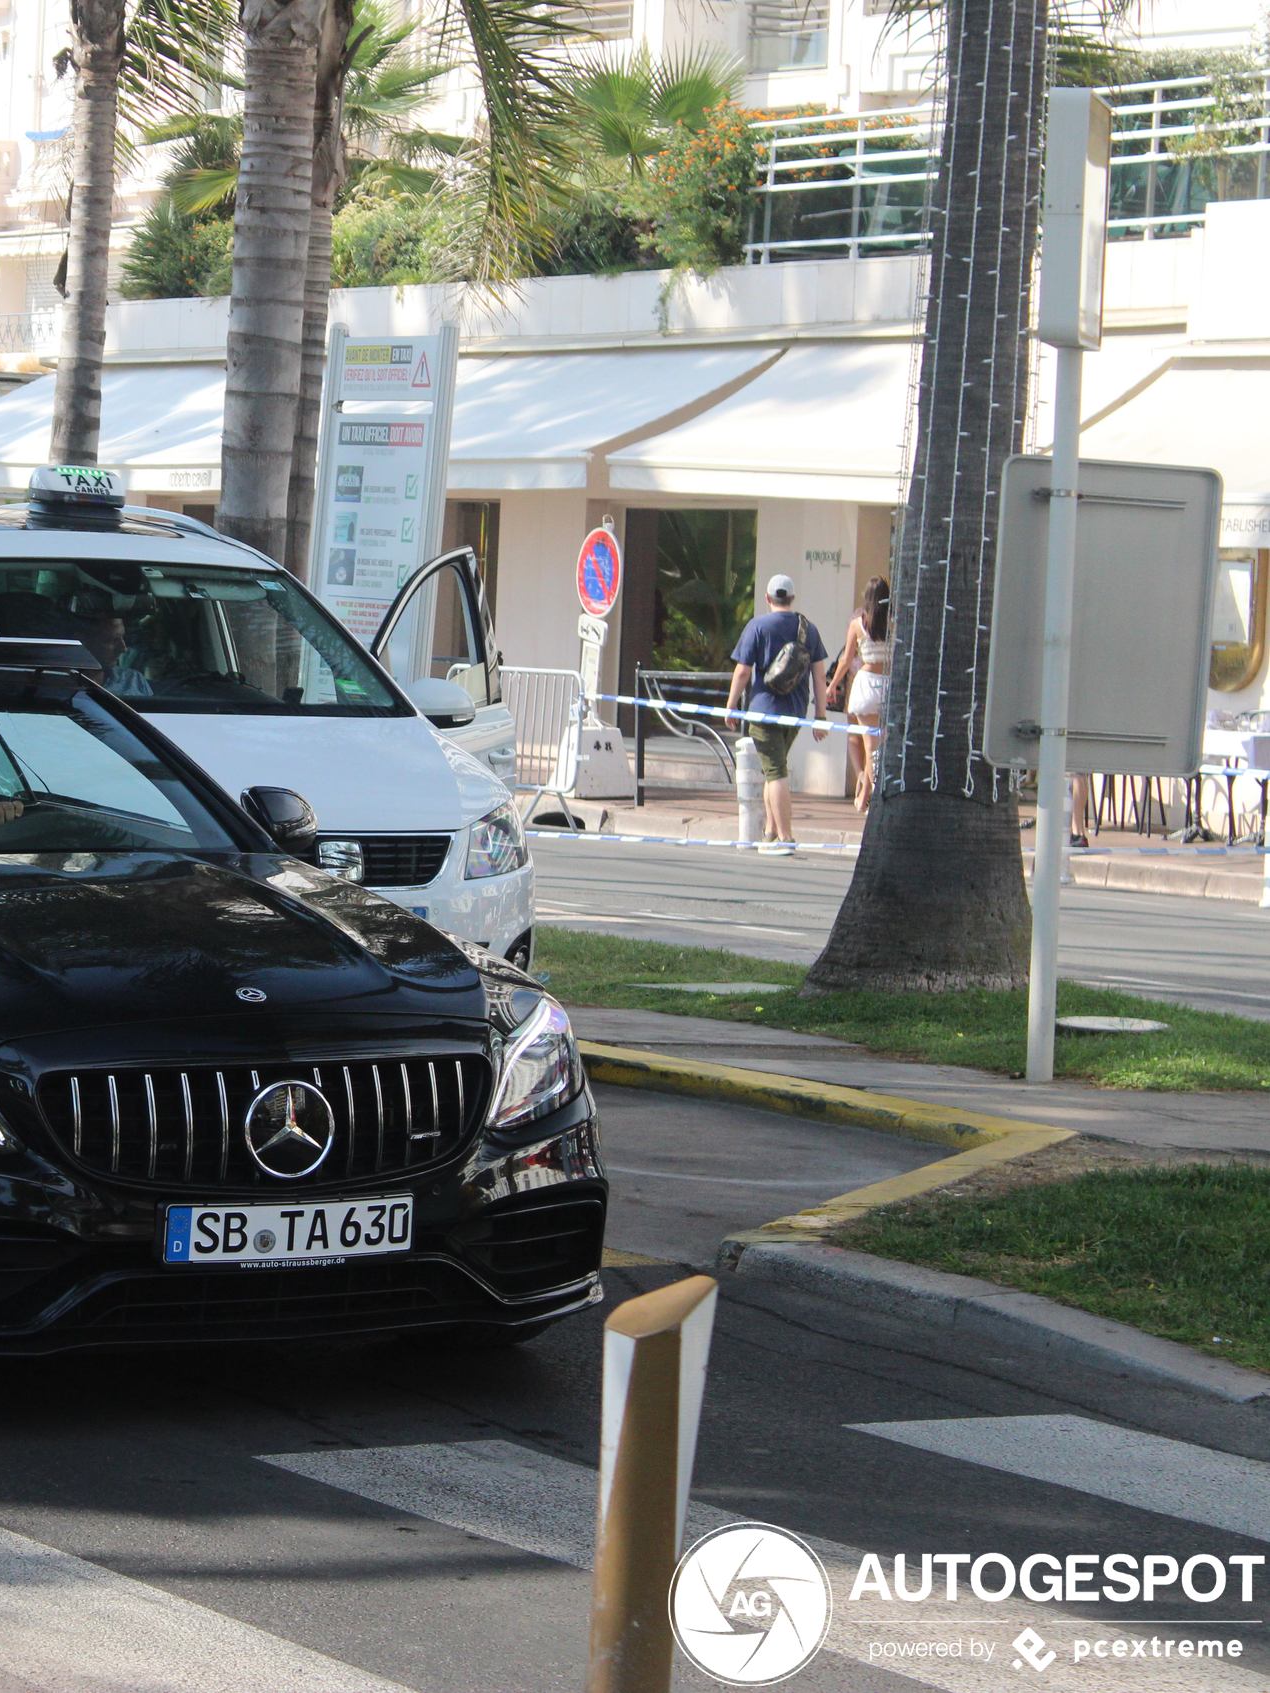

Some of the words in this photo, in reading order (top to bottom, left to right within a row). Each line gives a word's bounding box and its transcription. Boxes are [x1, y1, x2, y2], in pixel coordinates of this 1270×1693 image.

[342, 425, 351, 441] UN
[351, 426, 365, 441] TAXI
[364, 426, 389, 442] OFFICIEL
[390, 427, 405, 443] DOIT
[404, 427, 423, 443] AVOIR
[61, 474, 113, 489] TAXI
[75, 486, 110, 496] CANNES
[1221, 518, 1270, 533] TABLISHE
[194, 1211, 248, 1255] SB
[280, 1208, 329, 1251] TA
[340, 1203, 410, 1248] 630
[173, 1240, 183, 1253] D
[240, 1257, 346, 1269] www.auto-straussberger.de
